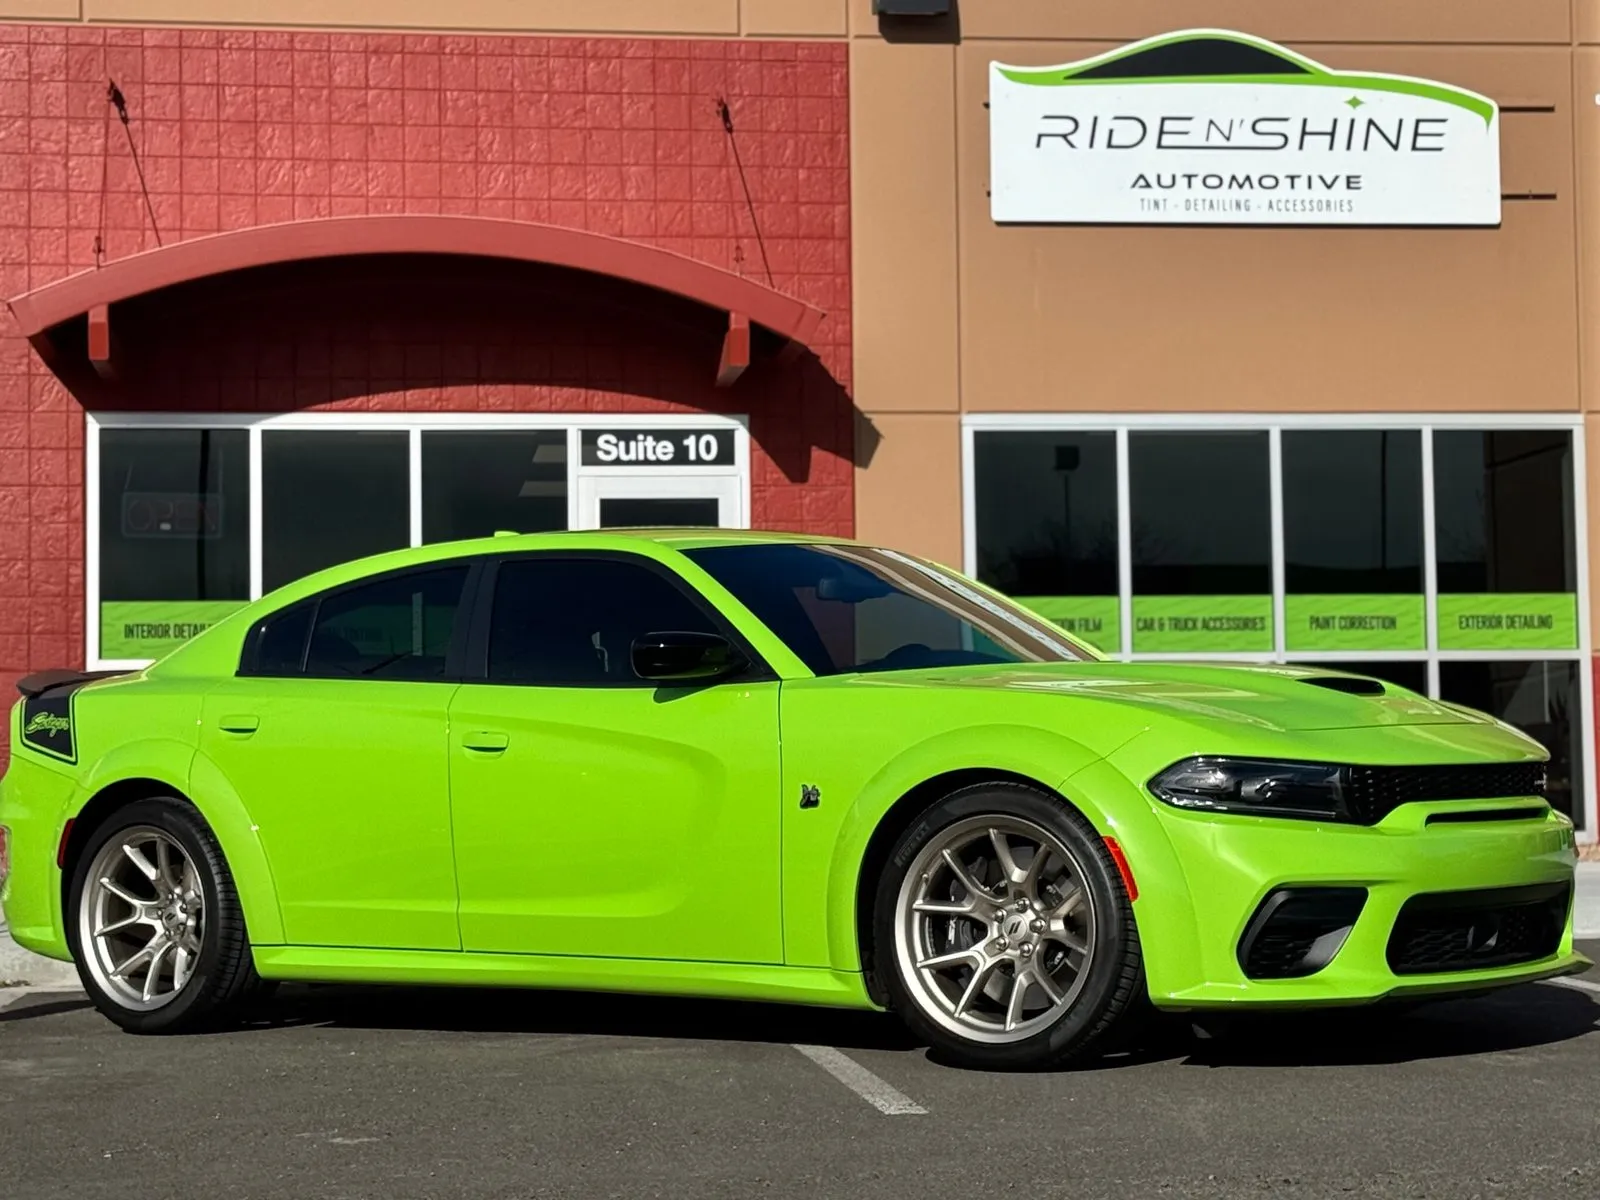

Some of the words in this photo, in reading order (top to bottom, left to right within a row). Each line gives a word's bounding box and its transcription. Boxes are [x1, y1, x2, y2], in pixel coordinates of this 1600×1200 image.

[1035, 115, 1194, 149] RIDE
[1251, 117, 1449, 151] SHINE
[1130, 173, 1363, 190] AUTOMOTIVE
[1140, 198, 1168, 211] TINT
[1184, 198, 1250, 212] DETAILING
[1267, 199, 1354, 213] ACCESSORIES
[597, 433, 675, 462] Suite
[683, 433, 719, 462] 10
[1079, 617, 1102, 632] FILM
[1136, 617, 1156, 632] CAR
[1167, 617, 1199, 631] TRUCK
[1201, 616, 1265, 631] ACCESSORIES
[1309, 615, 1336, 630] PAINT
[1338, 615, 1397, 630] CORRECTION
[1458, 615, 1503, 630] EXTERIOR
[1505, 614, 1553, 630] DETAILING
[124, 623, 171, 639] INTERIOR
